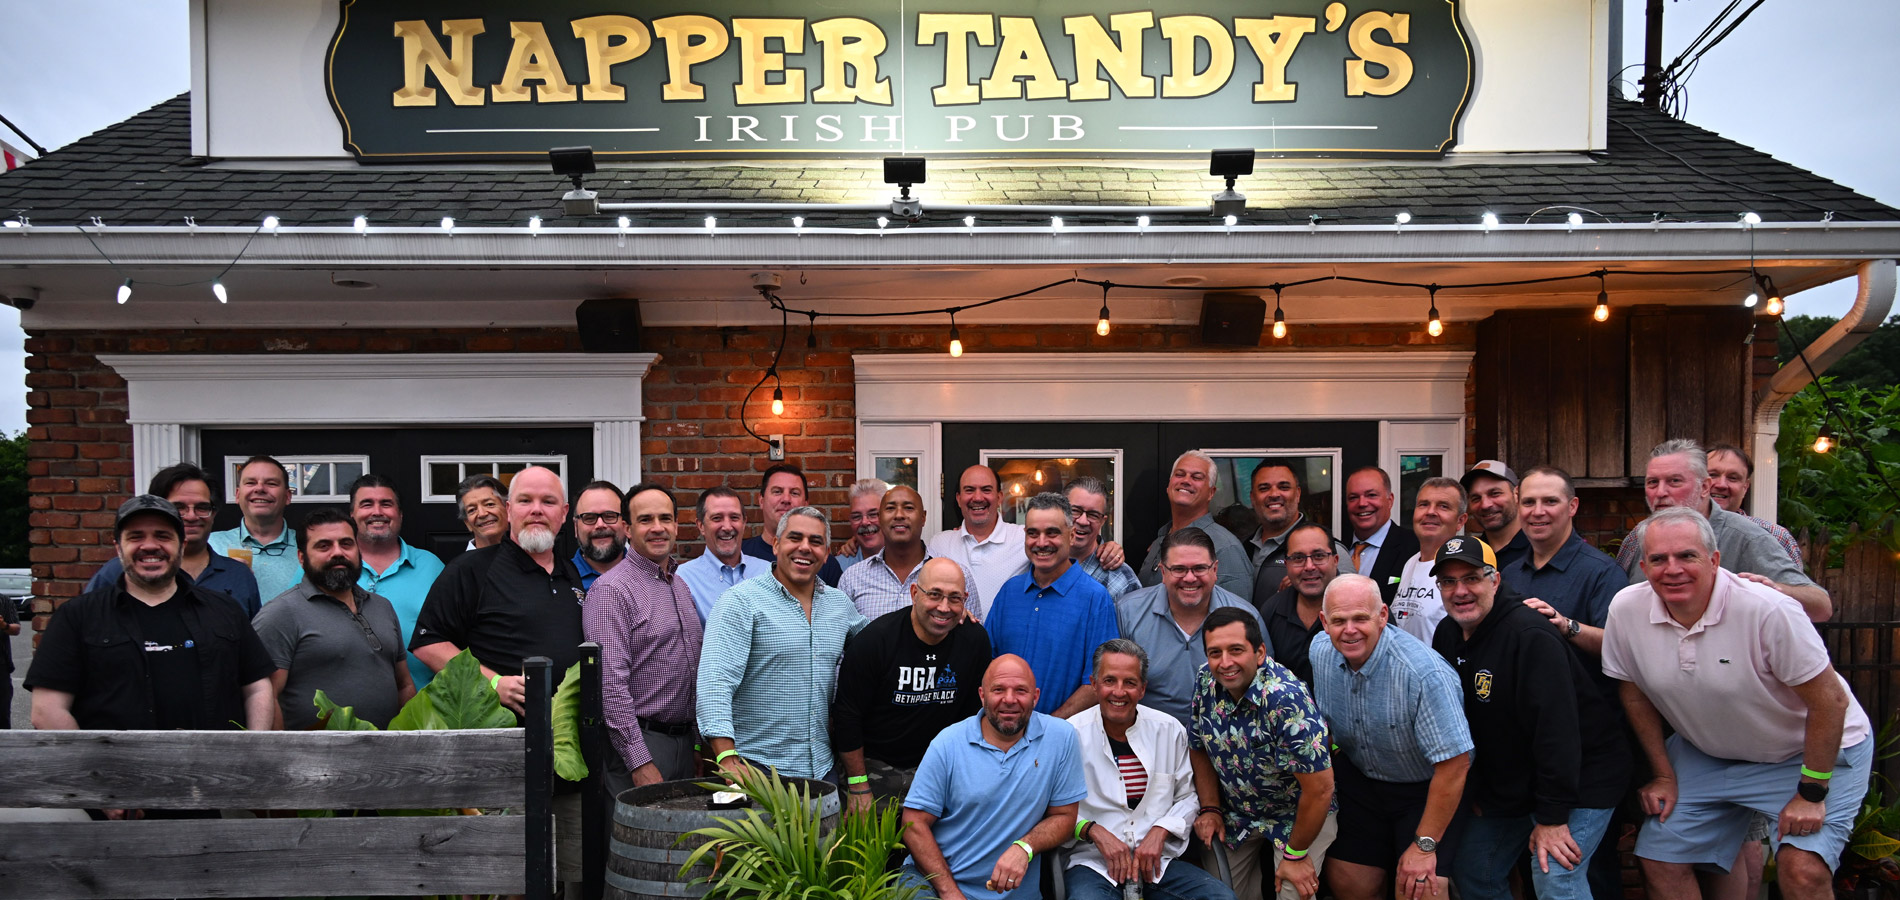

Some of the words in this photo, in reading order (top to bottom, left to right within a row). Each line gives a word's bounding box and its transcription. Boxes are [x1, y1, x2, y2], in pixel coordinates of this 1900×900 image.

[393, 15, 893, 106] NAPPER
[916, 2, 1416, 105] TANDY'S
[693, 115, 901, 142] IRISH
[944, 115, 1086, 142] PUB
[898, 666, 937, 691] PGA
[937, 676, 956, 684] PGA
[895, 693, 932, 703] BETHPAGE
[932, 690, 955, 700] BLACK
